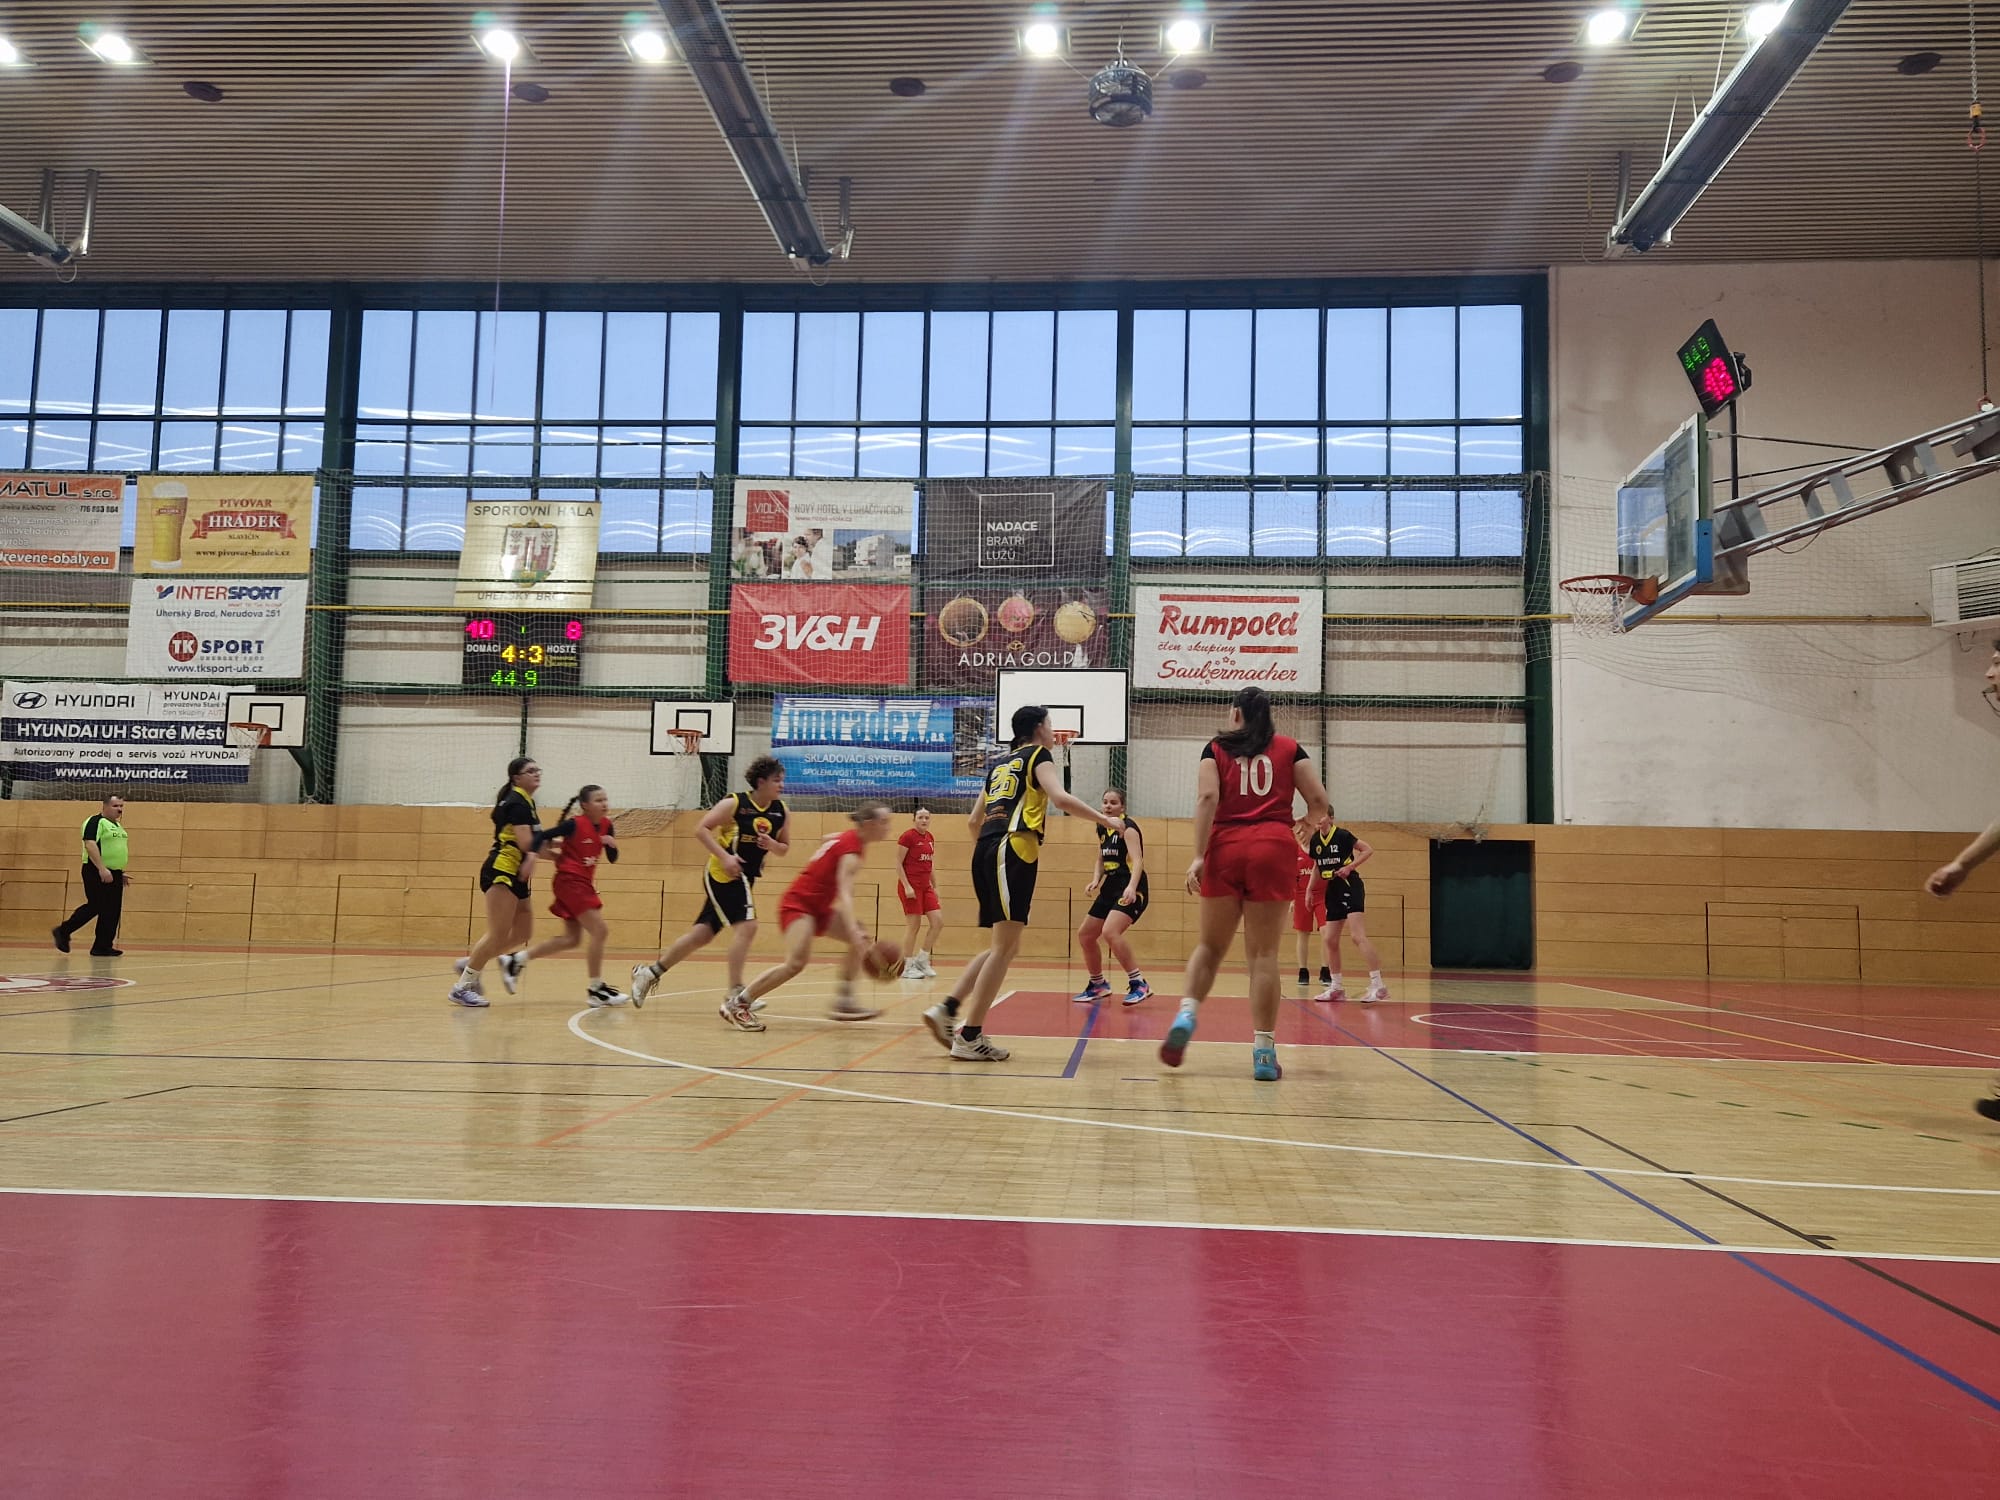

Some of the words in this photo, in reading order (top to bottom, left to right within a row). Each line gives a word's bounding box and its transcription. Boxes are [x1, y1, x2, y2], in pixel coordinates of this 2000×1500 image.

[82, 488, 115, 498] s.r.o.
[219, 498, 272, 508] PIVOVAR
[817, 503, 840, 514] HOTEL
[473, 504, 550, 516] SPORTOVNÍ
[557, 506, 594, 517] HALA
[208, 513, 282, 528] HRÁDEK
[986, 521, 1038, 532] NADACE
[176, 586, 284, 600] INTERSPORT
[156, 609, 192, 619] Uherský
[194, 610, 218, 618] Brod,
[220, 610, 264, 618] Nerudova
[1158, 604, 1300, 640] Rumpold
[465, 619, 495, 640] 10
[566, 620, 582, 640] 8
[753, 614, 882, 651] 3V&H
[172, 639, 196, 654] TK
[201, 640, 264, 654] SPORT
[1158, 640, 1182, 651] člen
[1187, 640, 1236, 655] skupiny
[958, 652, 1016, 666] ADRIA
[1020, 652, 1074, 666] GOLD
[167, 664, 264, 674] www.tksport-ub.cz
[1157, 659, 1298, 682] Saubermacher
[55, 694, 135, 708] HYUNDAI
[164, 691, 220, 700] HYUNDAI
[17, 722, 98, 738] HYUNDAI
[101, 724, 127, 738] UH
[131, 724, 178, 740] Staré
[14, 748, 74, 758] Autorizovaný
[80, 748, 112, 759] prodej
[128, 750, 157, 758] servis
[162, 750, 186, 758] vozů
[190, 750, 239, 760] HYUNDAI
[55, 767, 188, 780] www.uh.hyundai.cz
[1234, 753, 1274, 797] 10
